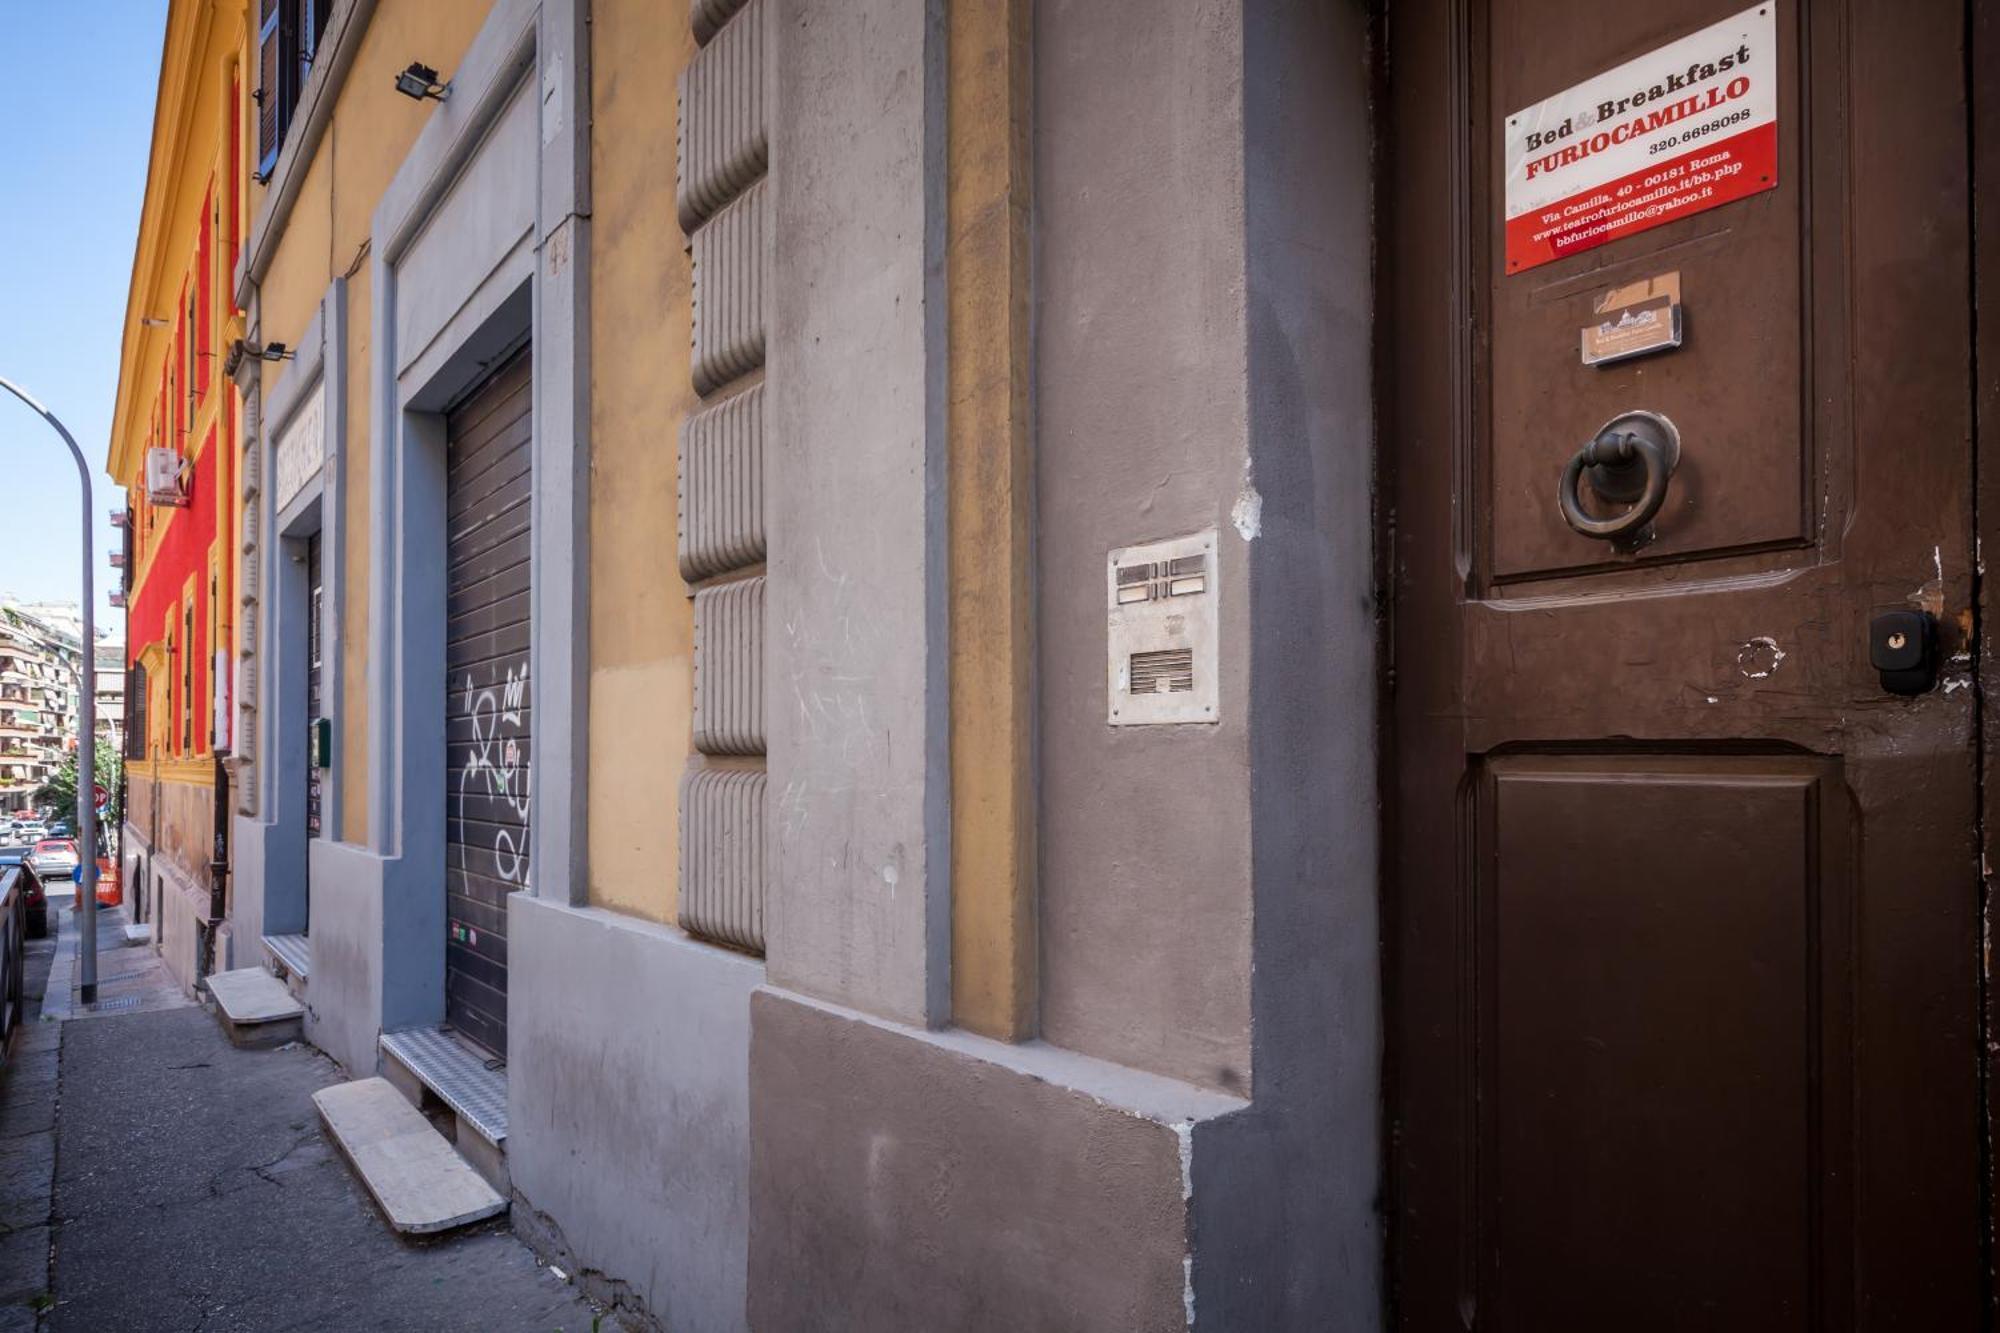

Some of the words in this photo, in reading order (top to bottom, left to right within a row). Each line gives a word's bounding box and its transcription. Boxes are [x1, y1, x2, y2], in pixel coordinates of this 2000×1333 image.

[1525, 118, 1573, 152] Bed
[1596, 44, 1750, 123] Breakfast
[1525, 76, 1751, 180] FURIOCAMILLO
[1649, 108, 1751, 155] 320.6698098
[1532, 162, 1742, 242] www.teatrofuriocamillo.it/bb.php
[1542, 212, 1561, 224] Via
[1616, 184, 1633, 197] 40
[1644, 165, 1685, 188] 00181
[1690, 151, 1731, 172] Roma
[1556, 186, 1713, 248] bbfuriocamillo@yahoo.it
